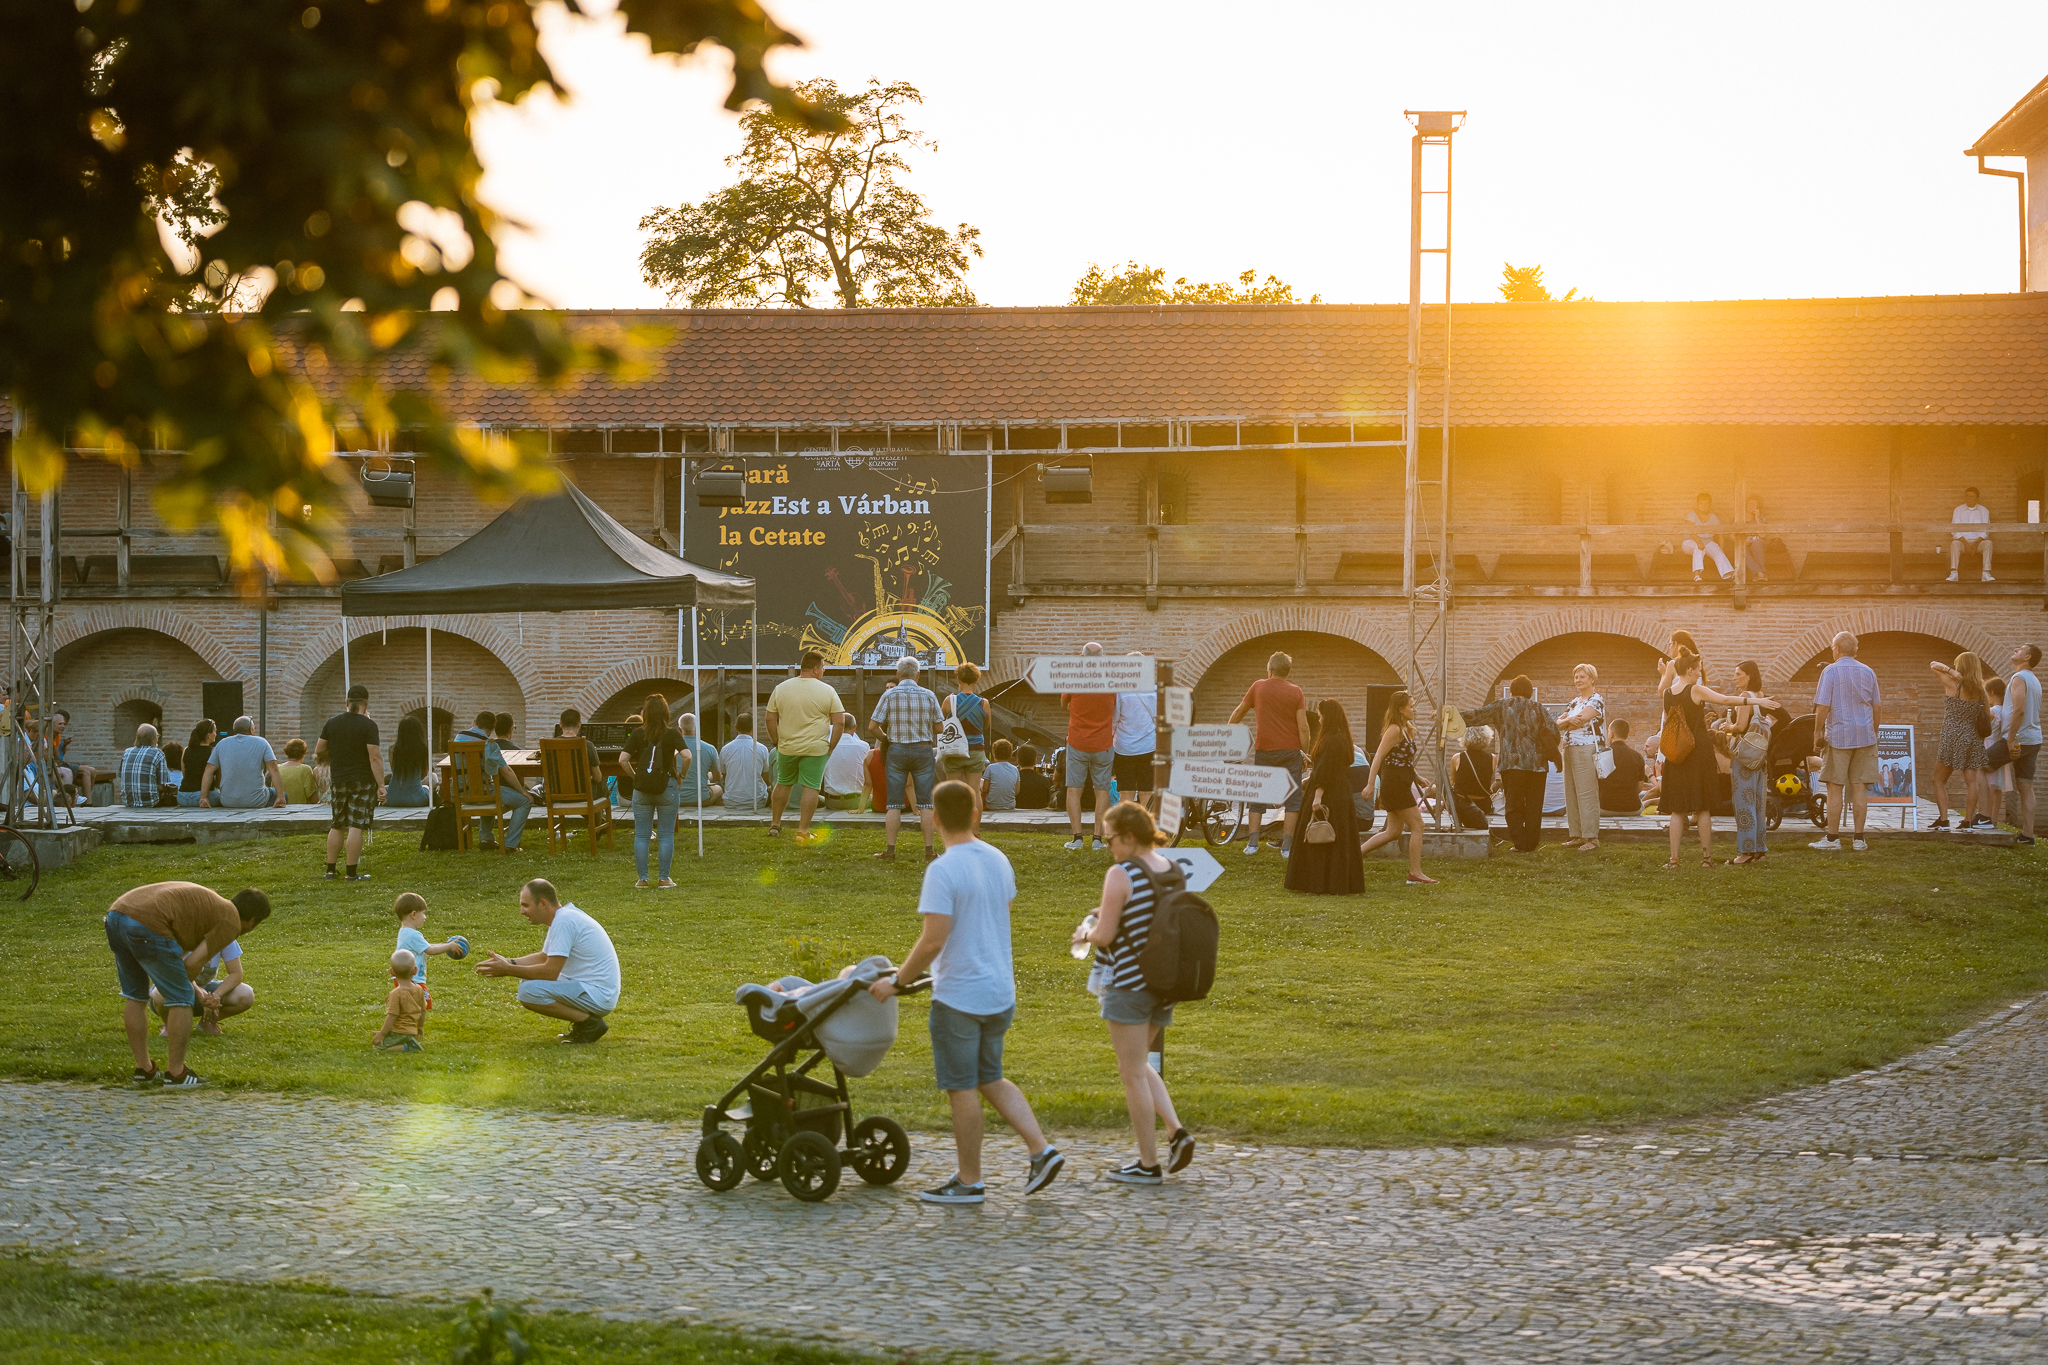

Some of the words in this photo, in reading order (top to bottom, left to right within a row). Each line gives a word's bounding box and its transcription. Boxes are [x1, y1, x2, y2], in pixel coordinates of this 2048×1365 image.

[816, 500, 831, 515] a
[838, 493, 930, 515] Várban
[719, 525, 742, 545] la
[749, 526, 826, 546] Cetate
[1050, 660, 1084, 668] Centrul
[1086, 660, 1097, 668] de
[1099, 660, 1142, 668] informare
[1049, 671, 1102, 679] Információs
[1053, 681, 1105, 689] Information
[1108, 681, 1138, 689] Centre
[1188, 729, 1215, 737] Bastionul
[1187, 749, 1210, 757] Bastion
[1229, 749, 1243, 757] Gate
[1184, 763, 1226, 774] Bastionul
[1227, 767, 1272, 778] Croitorilor
[1191, 774, 1223, 785] Szabók
[1225, 777, 1263, 788] Bástyája
[1226, 788, 1259, 798] Bastion
